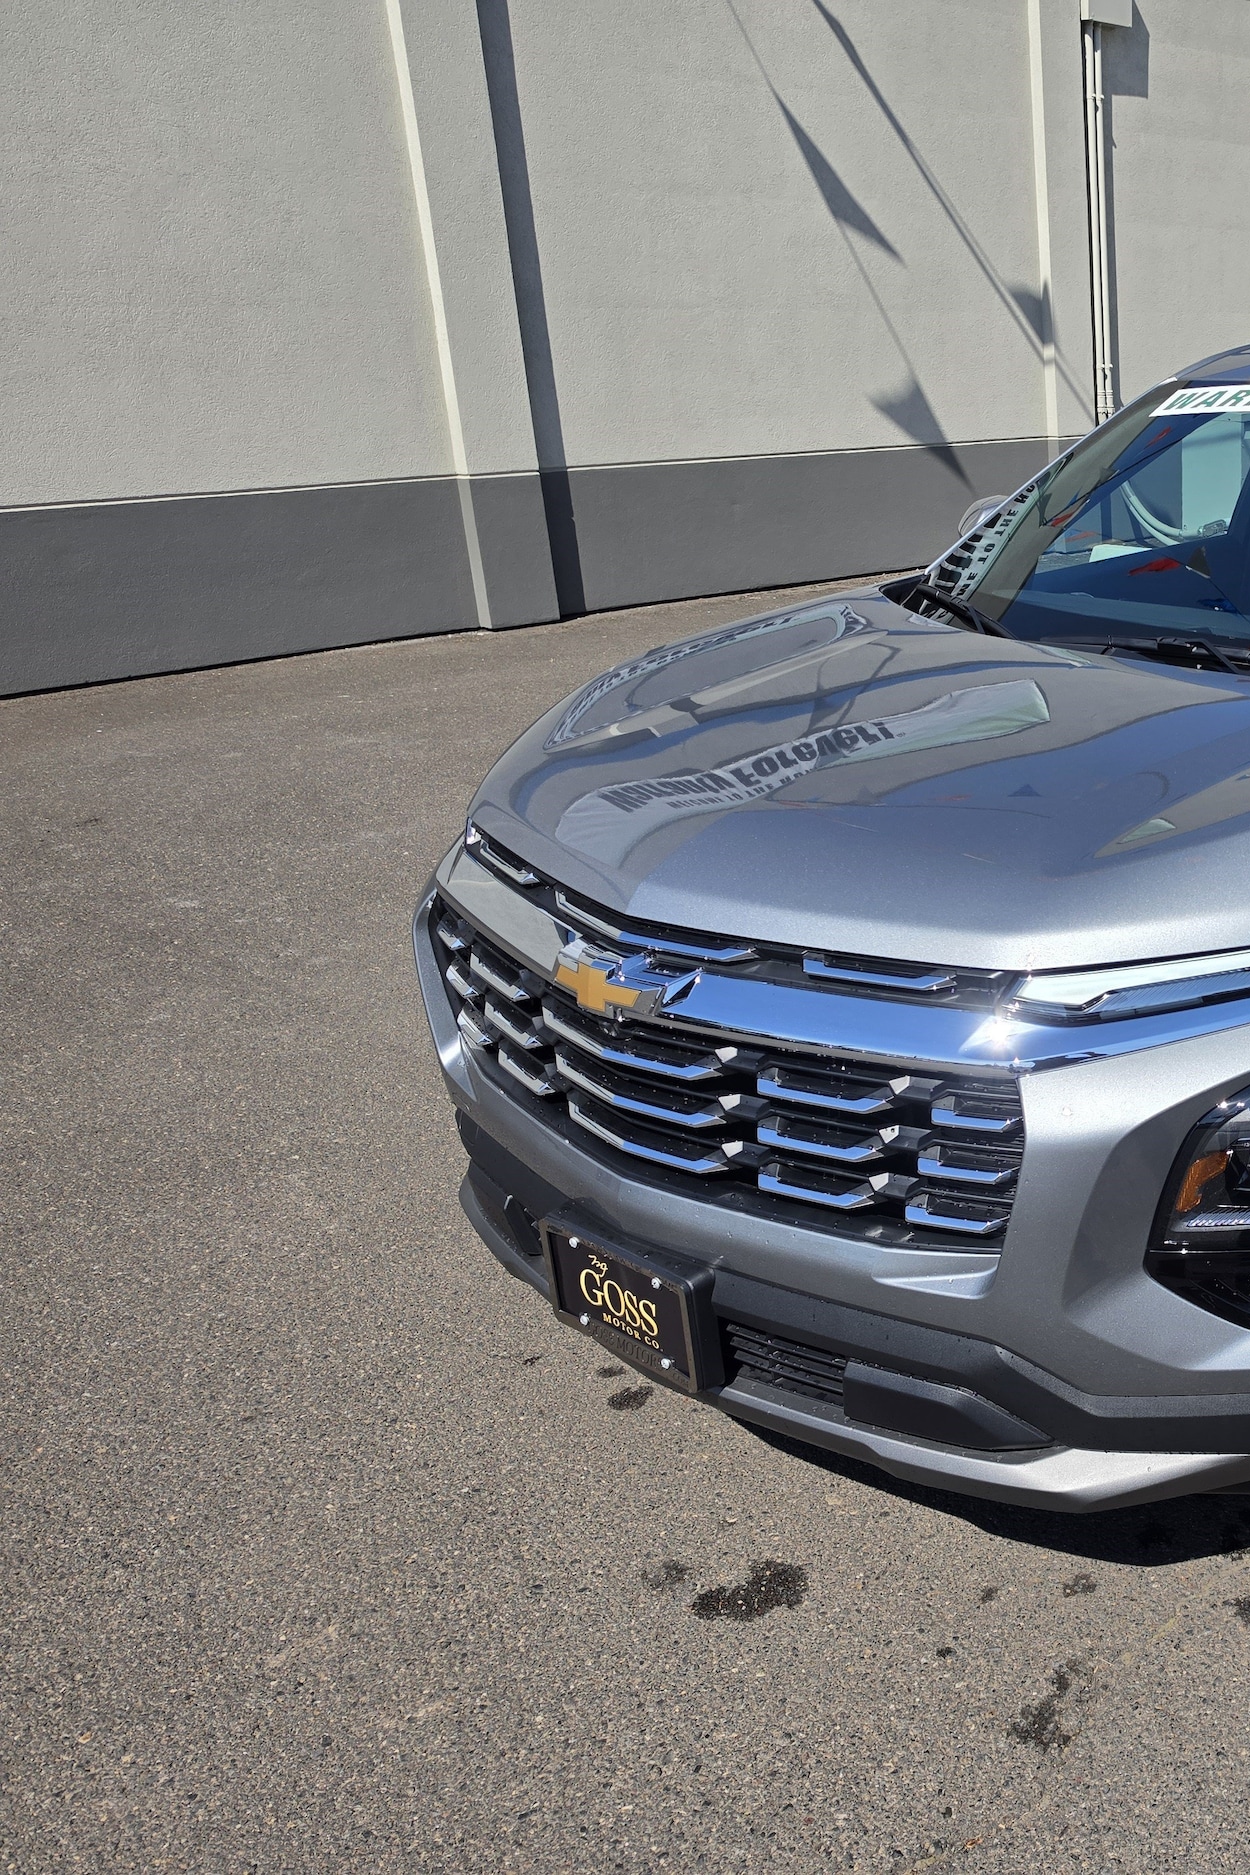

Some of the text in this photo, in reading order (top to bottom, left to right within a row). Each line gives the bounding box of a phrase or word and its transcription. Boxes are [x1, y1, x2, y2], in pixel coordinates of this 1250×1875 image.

[580, 1268, 659, 1337] GOSS
[602, 1313, 665, 1352] MOTOR CO.
